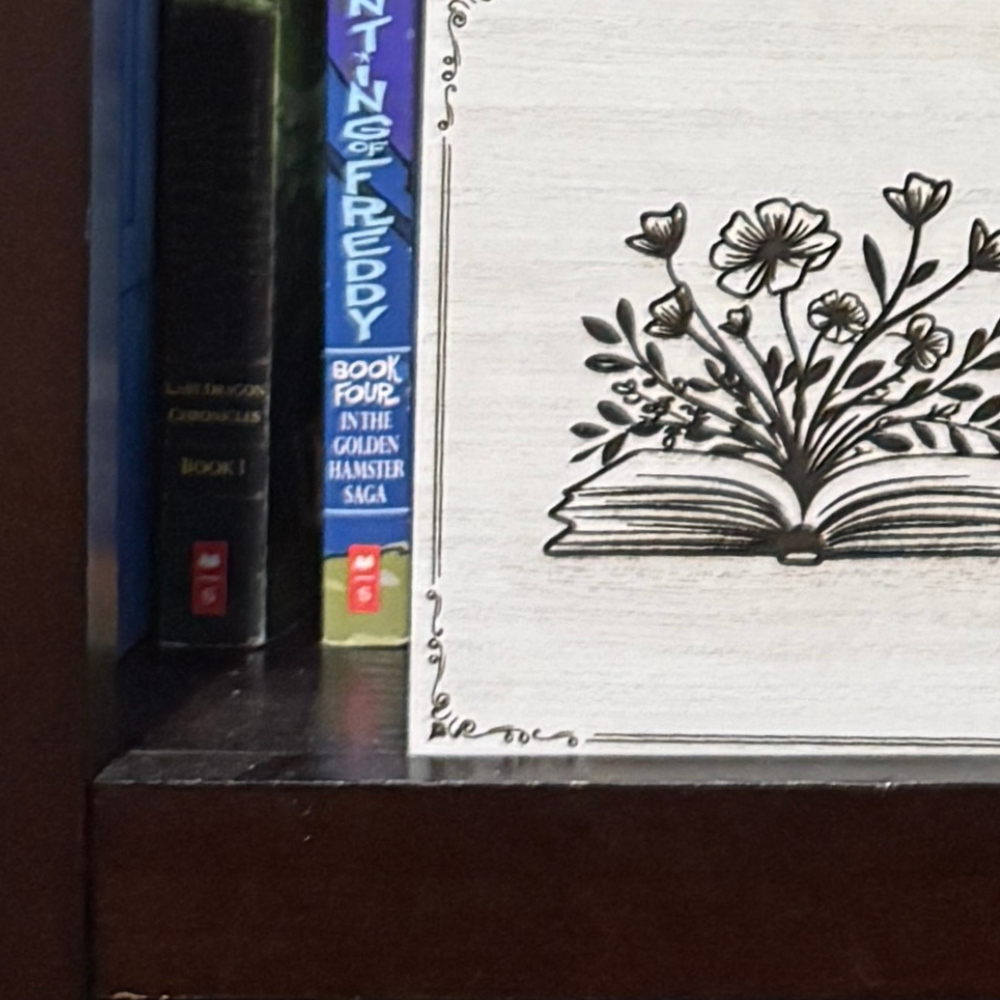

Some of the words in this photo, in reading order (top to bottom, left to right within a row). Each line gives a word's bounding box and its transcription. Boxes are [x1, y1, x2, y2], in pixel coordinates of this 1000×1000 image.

[348, 140, 389, 158] OF
[342, 157, 395, 342] FREDDY
[331, 355, 403, 384] BOOK
[334, 381, 401, 408] FOUR
[340, 410, 359, 431] IN
[361, 410, 393, 431] THE
[332, 434, 399, 456] GOLDEN
[328, 459, 405, 481] HAMSTER
[343, 484, 387, 504] SAGA
